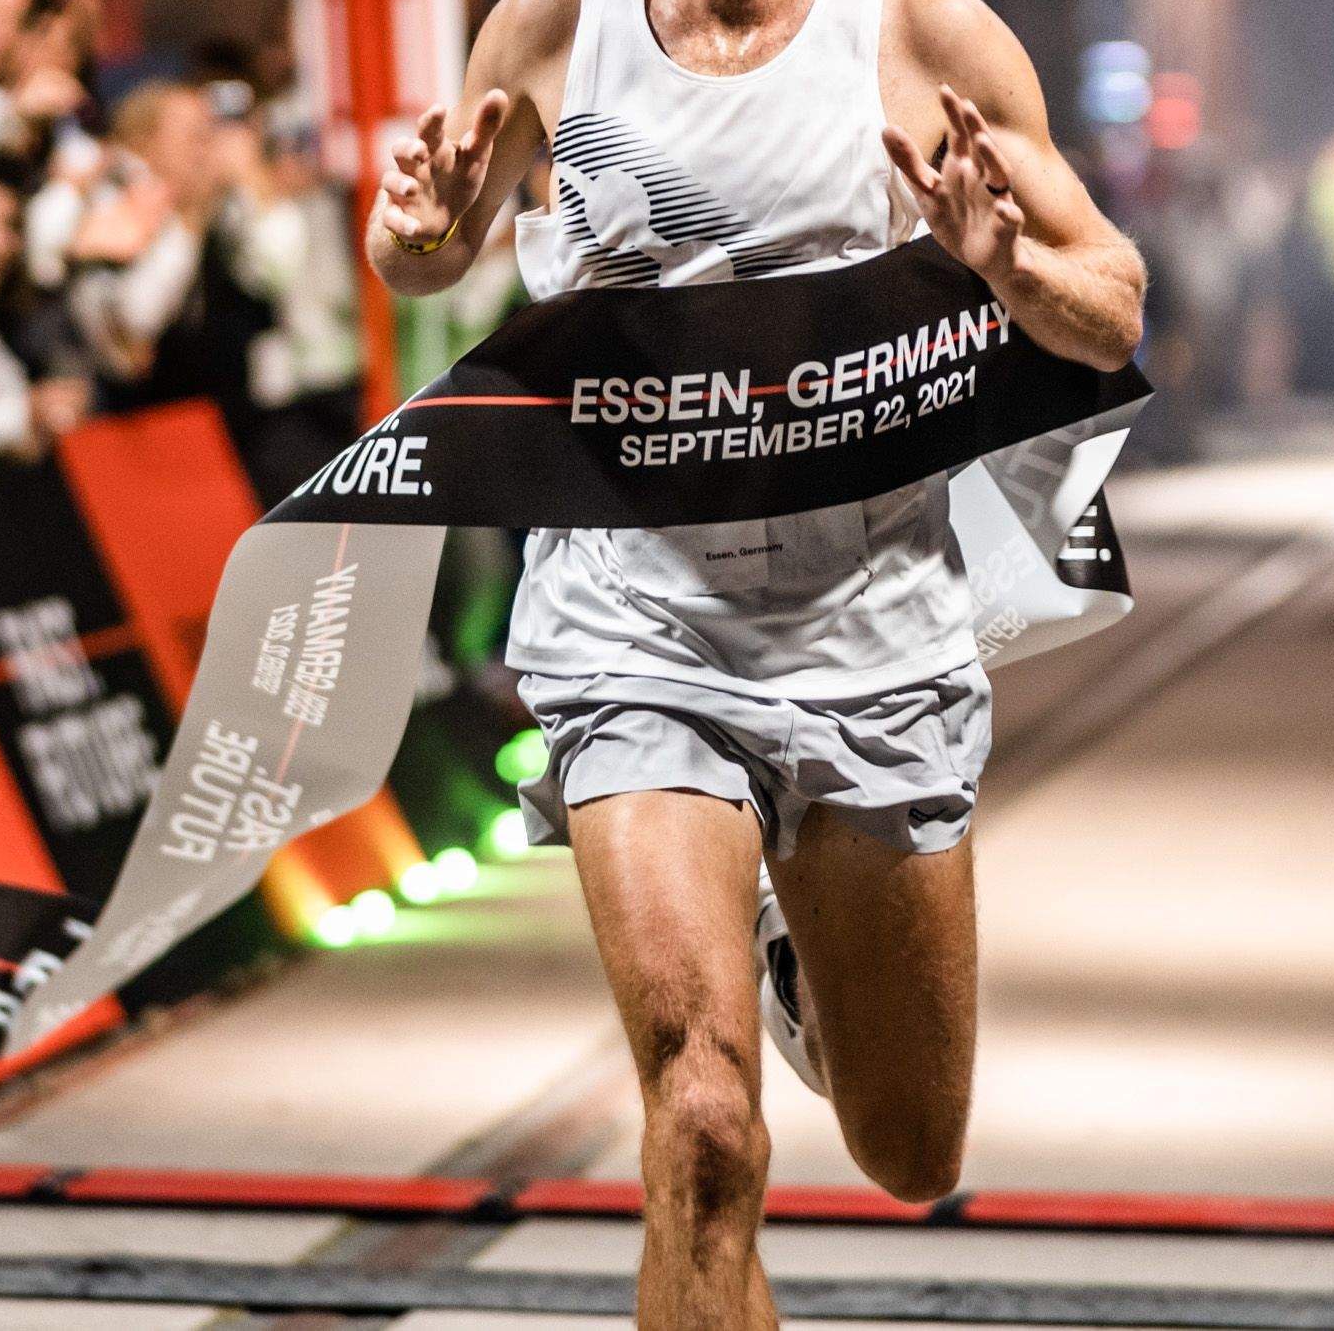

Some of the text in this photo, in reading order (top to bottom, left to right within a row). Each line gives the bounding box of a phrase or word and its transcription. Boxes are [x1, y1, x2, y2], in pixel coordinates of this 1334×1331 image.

[571, 300, 1012, 424] ESSEN, GERMANY
[620, 366, 977, 468] SEPTEMBER 22, 2021
[705, 542, 784, 562] Essen, Germany
